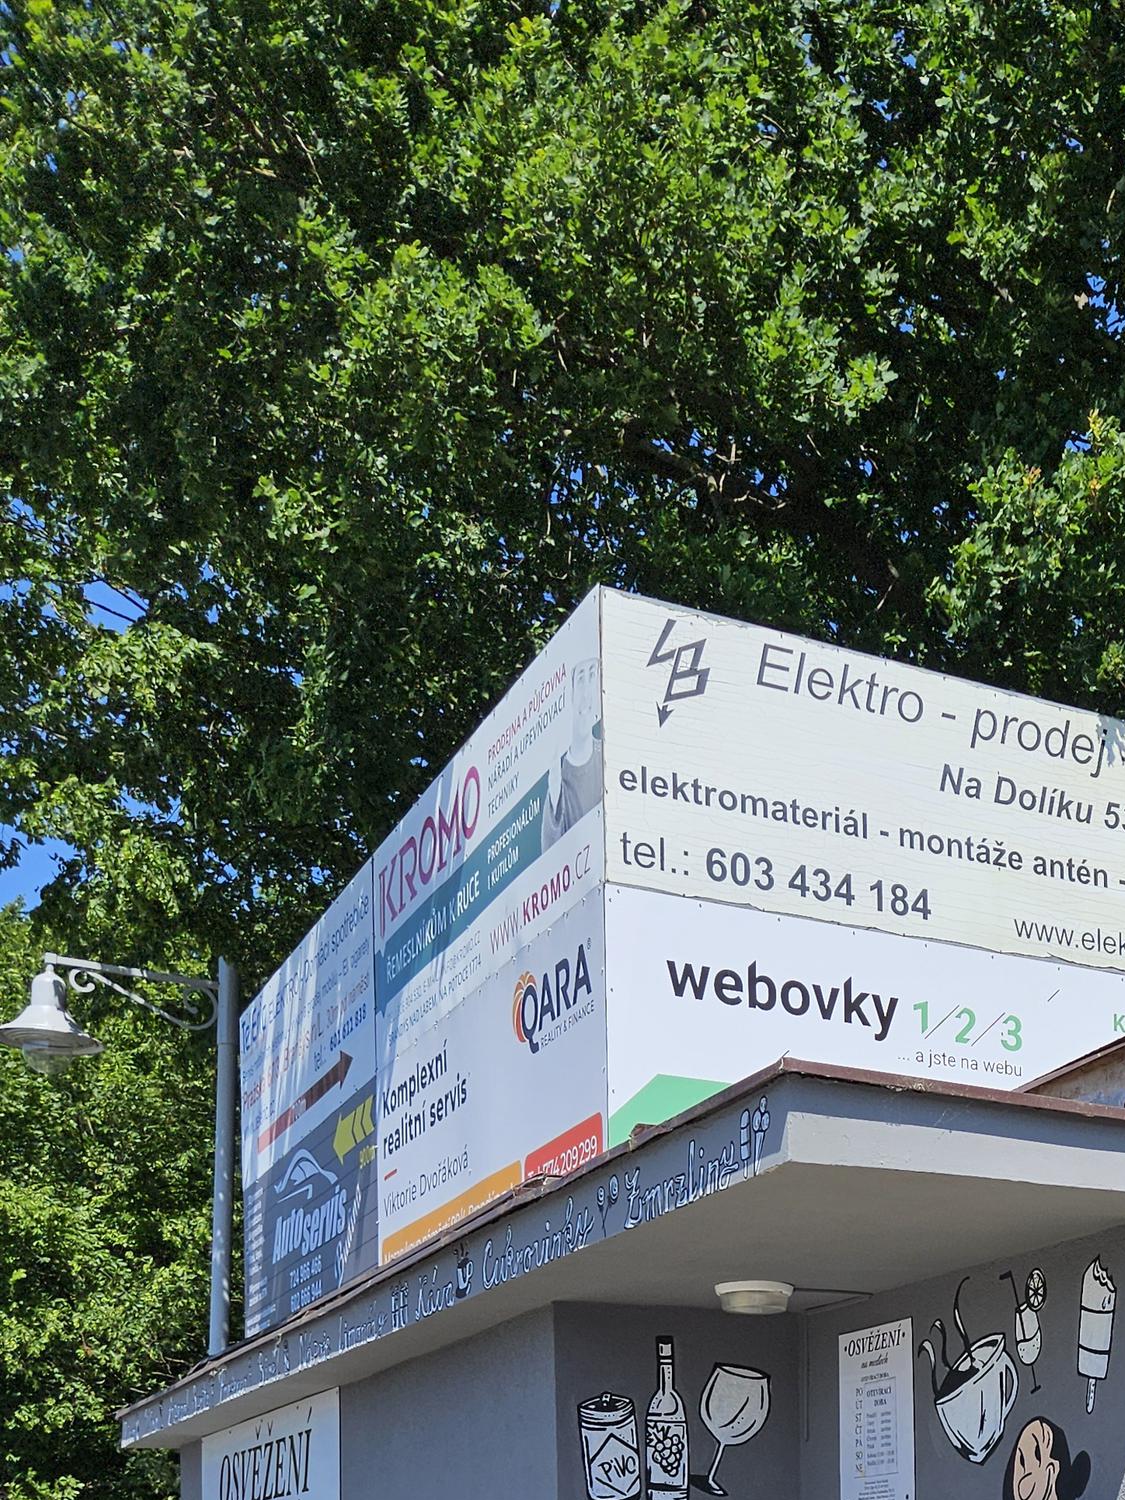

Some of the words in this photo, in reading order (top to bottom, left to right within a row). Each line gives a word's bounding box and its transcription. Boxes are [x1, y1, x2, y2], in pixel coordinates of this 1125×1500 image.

[487, 719, 521, 765] PRODEJNA
[528, 663, 568, 713] PŮJČOVNA
[756, 643, 925, 723] Elektro
[970, 707, 1108, 778] prodej
[487, 750, 513, 793] NÁŘADÍ
[487, 771, 520, 819] TECHNIKY
[939, 763, 982, 800] Na
[994, 774, 1093, 824] Dolíku
[379, 766, 481, 940] KROMO
[487, 796, 541, 864] PROFESIONÁLŮM
[491, 845, 520, 885] KUTILŮM
[619, 765, 868, 839] elektromateriál
[898, 826, 1024, 871] montáže
[1033, 855, 1109, 888] antén
[489, 844, 591, 954] WWW.KROMO.CZ
[619, 832, 690, 877] tel.:
[705, 848, 775, 892] 603
[788, 864, 856, 906] 434
[869, 879, 932, 921] 184
[386, 904, 447, 984] ŘEMESLNÍKŮM
[457, 870, 481, 916] RUCE
[521, 943, 593, 1054] QARA
[666, 959, 899, 1042] webovky
[382, 1039, 448, 1119] Komplexní
[927, 1049, 957, 1070] jste
[961, 1056, 979, 1071] na
[982, 1058, 1023, 1078] webu
[383, 1100, 426, 1160] realitní
[430, 1072, 468, 1128] servis
[560, 1145, 579, 1174] 209
[579, 1135, 598, 1165] 299
[383, 1180, 417, 1217] Viktorie
[419, 1144, 469, 1197] Dvořáková
[623, 1140, 739, 1230] Zmrzliny
[272, 1185, 347, 1264] Autoservis
[847, 1323, 902, 1358] OSVĚŽENÍ
